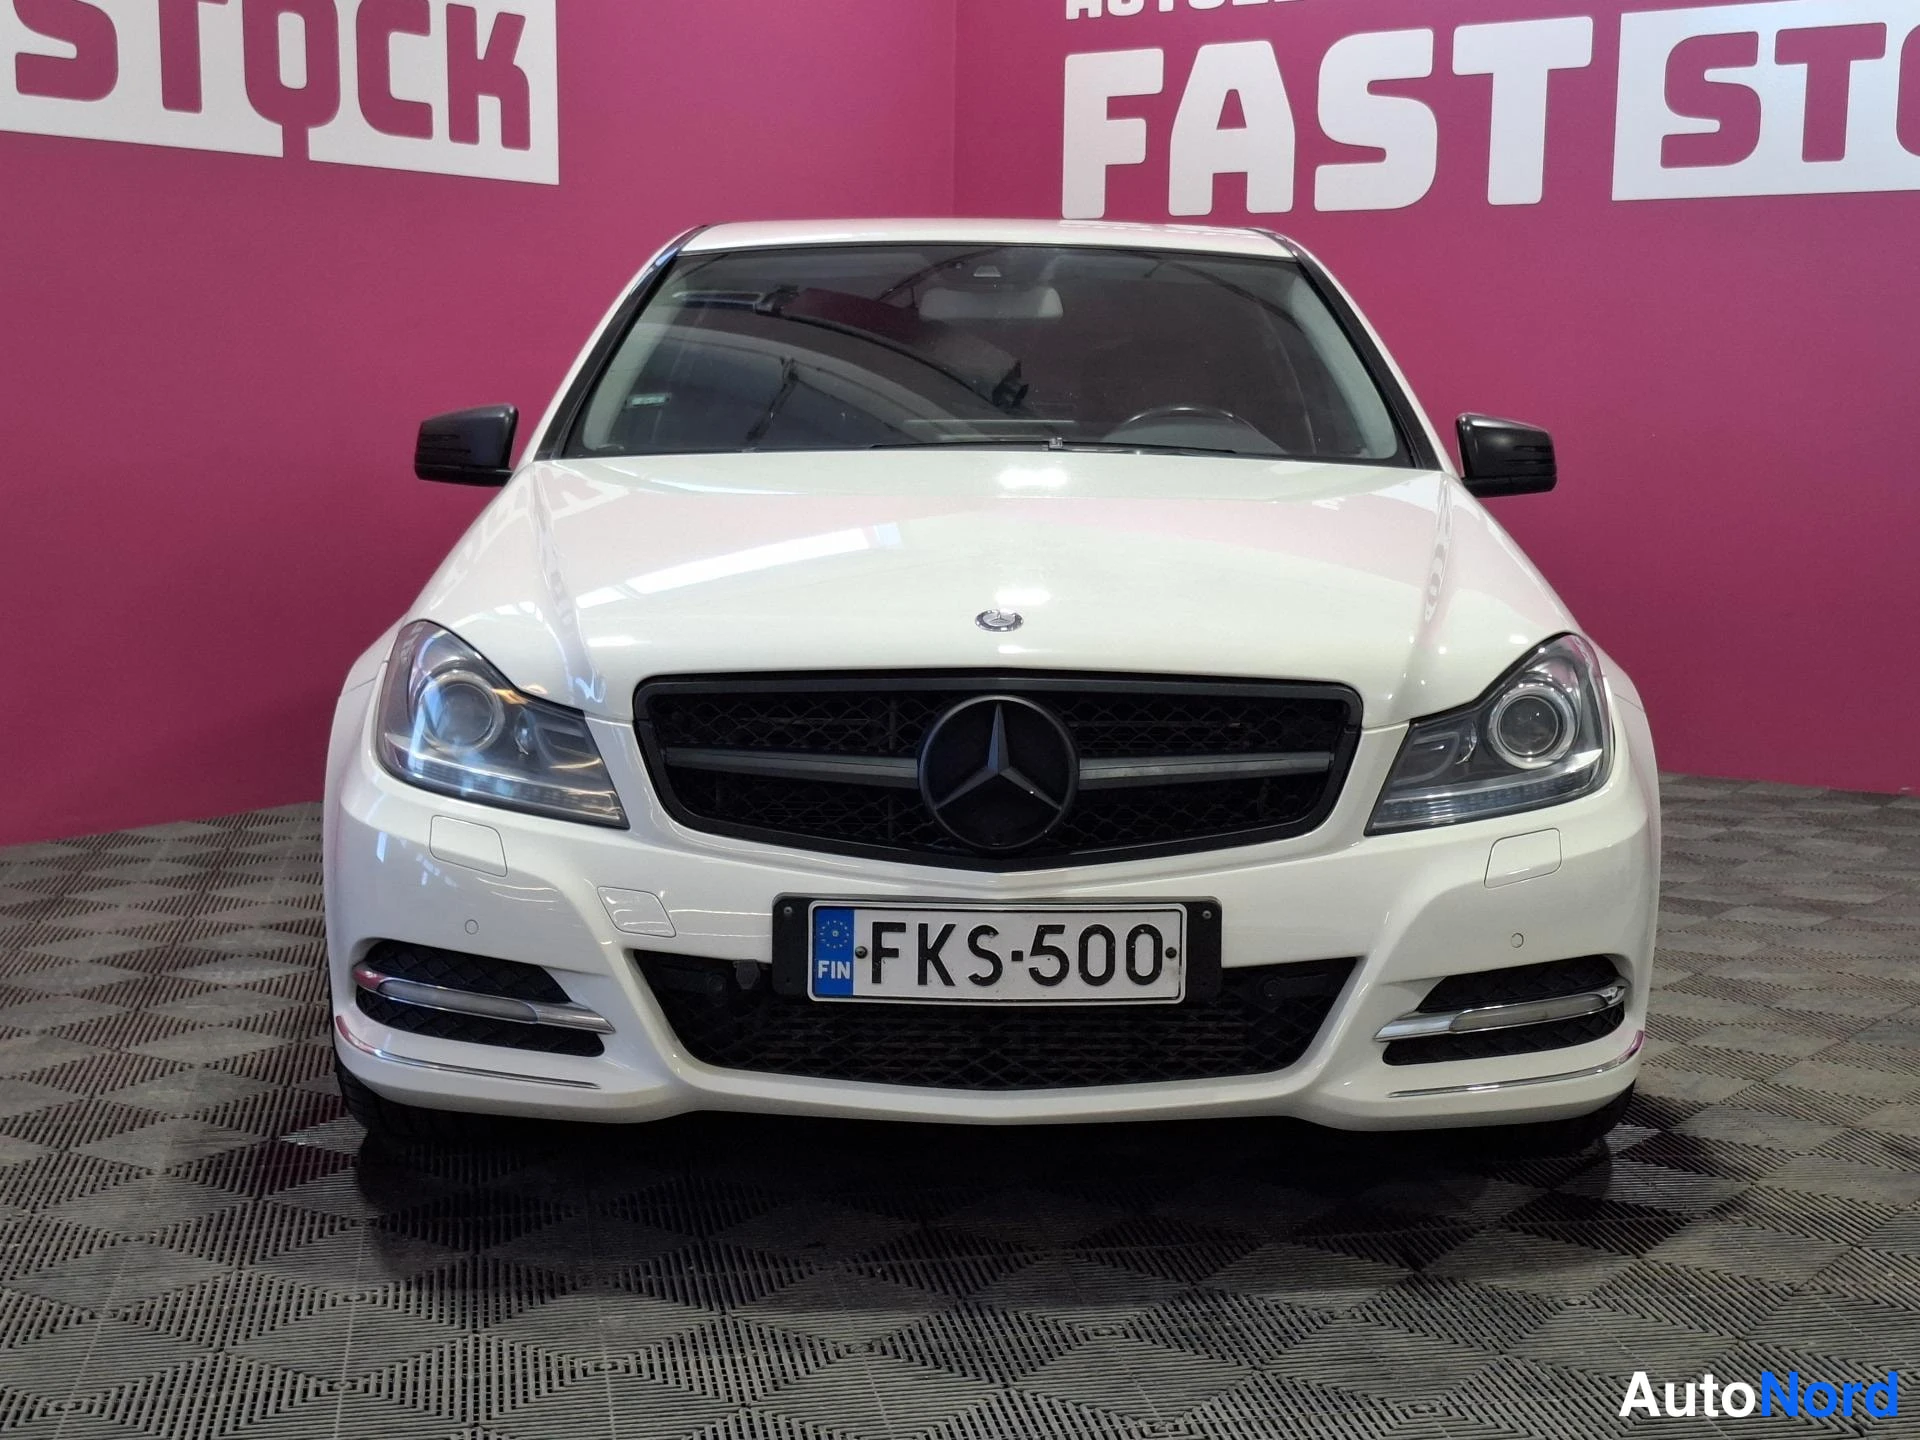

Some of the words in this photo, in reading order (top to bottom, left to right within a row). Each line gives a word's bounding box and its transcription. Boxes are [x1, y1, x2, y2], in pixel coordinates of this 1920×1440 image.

[13, 0, 531, 151] STOCK
[1062, 16, 1593, 219] FAST
[1660, 22, 1920, 169] ST
[818, 960, 851, 979] FIN
[871, 921, 1164, 986] FKS-500
